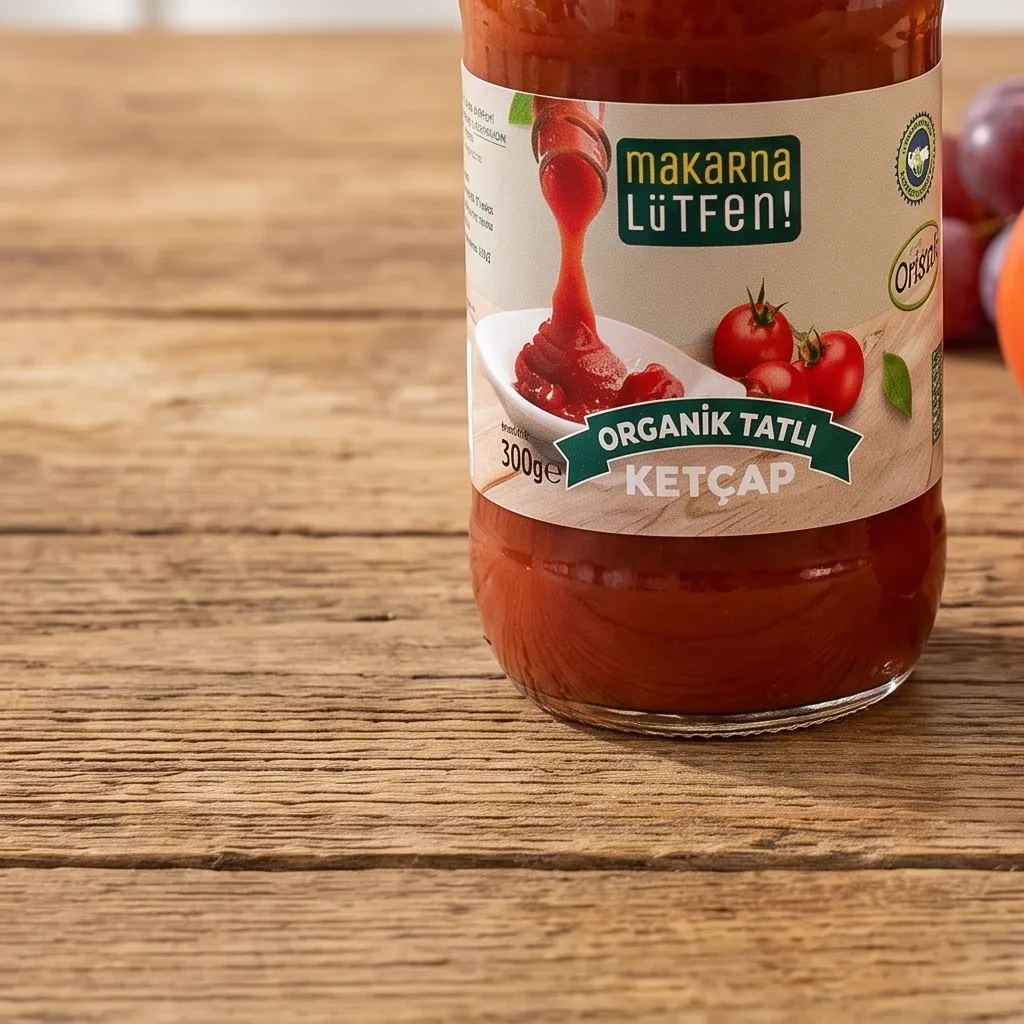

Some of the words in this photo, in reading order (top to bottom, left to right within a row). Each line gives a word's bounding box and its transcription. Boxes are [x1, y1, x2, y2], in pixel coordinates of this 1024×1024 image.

[627, 190, 791, 233] LüTFen!
[598, 403, 732, 451] ORGANİK
[739, 412, 818, 449] TATLI
[625, 461, 796, 506] KETÇAP
